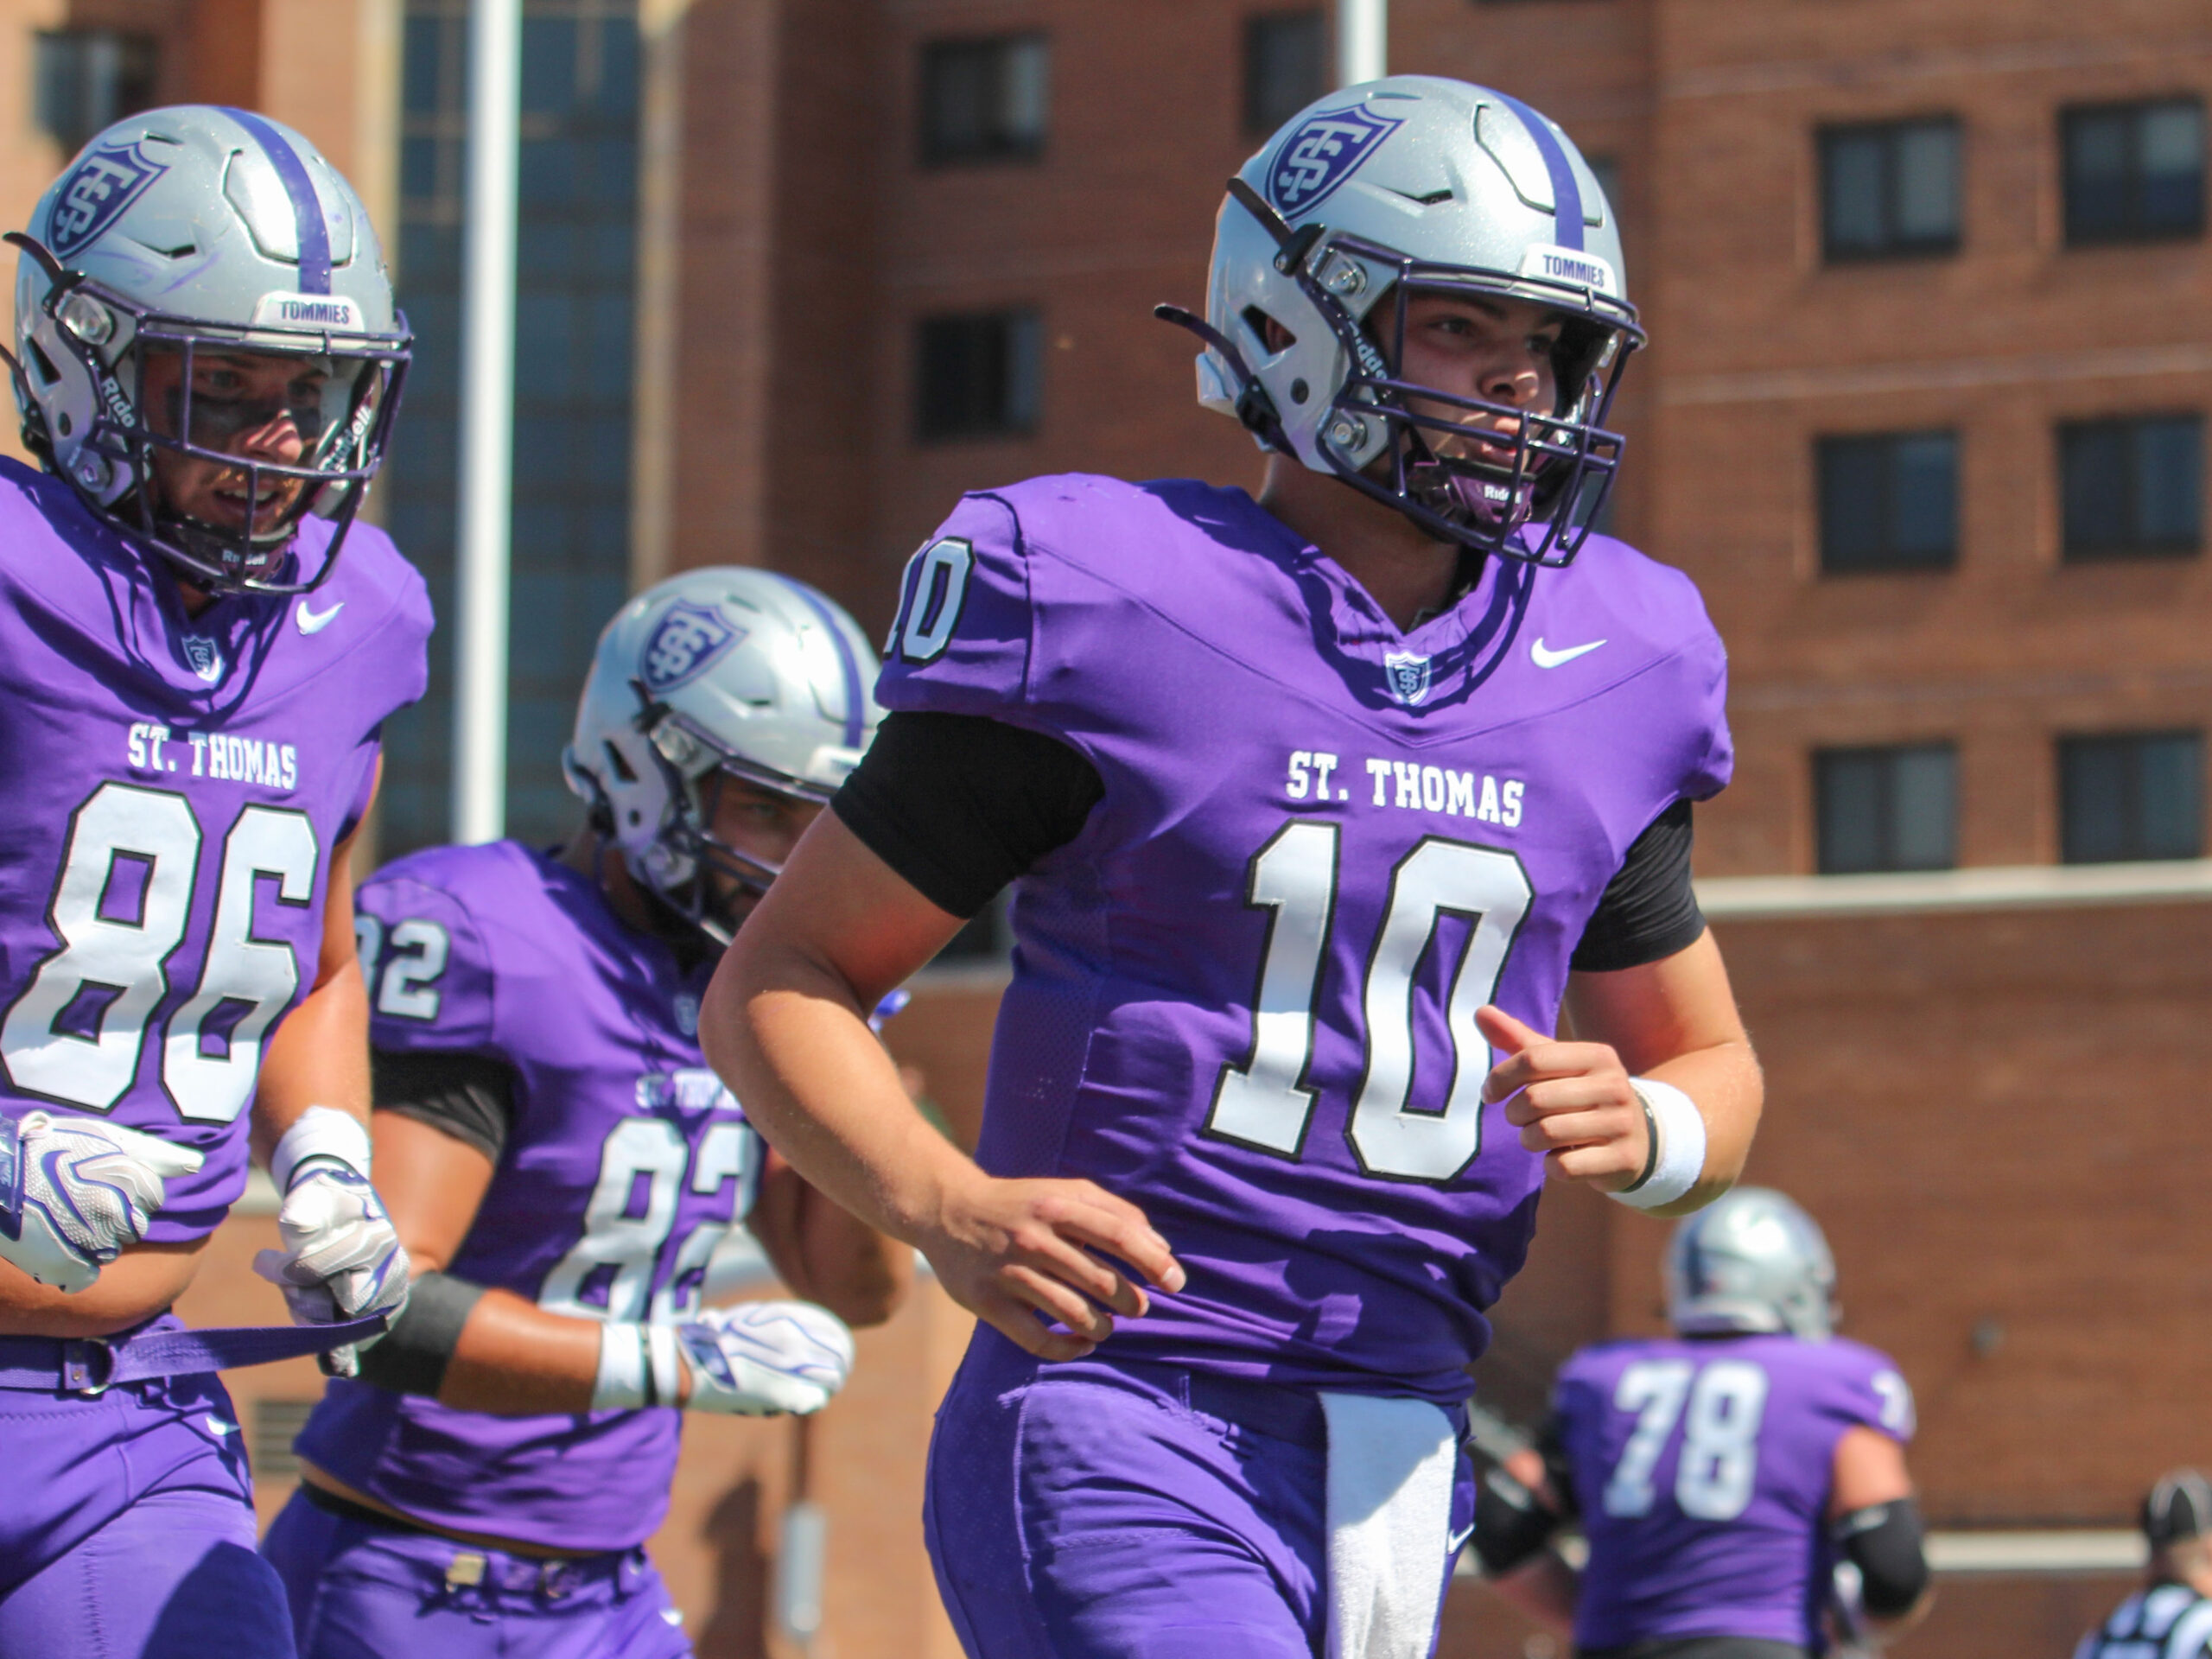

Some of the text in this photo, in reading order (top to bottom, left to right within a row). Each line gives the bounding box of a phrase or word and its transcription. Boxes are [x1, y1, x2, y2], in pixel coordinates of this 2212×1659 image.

[280, 300, 350, 325] TOMMIES
[1542, 253, 1605, 288] TOMMIES
[127, 721, 298, 791] ST. THOMAS
[1285, 750, 1525, 828] ST. THOMAS
[0, 780, 320, 1125] 86
[1198, 817, 1535, 1182] 10
[537, 1117, 760, 1325] 82
[1603, 1357, 1769, 1522] 78
